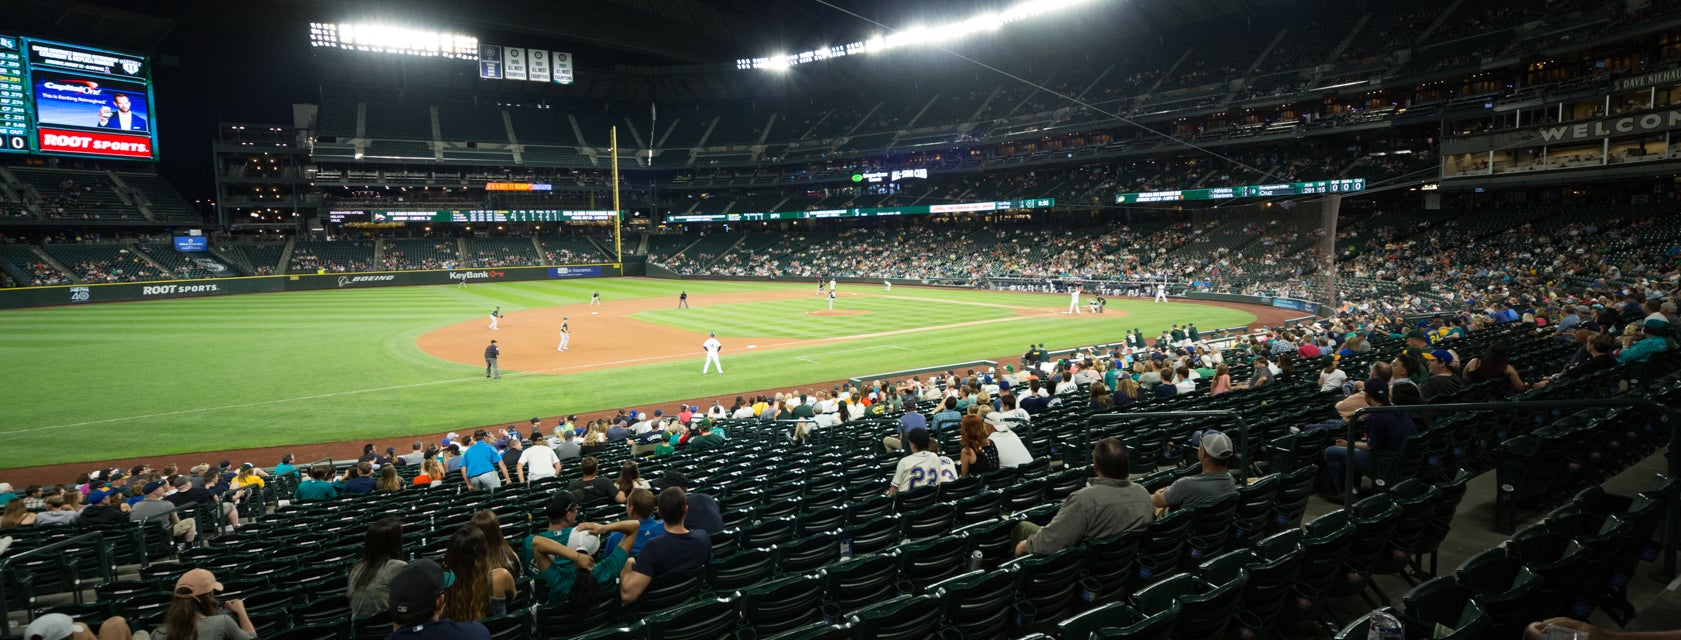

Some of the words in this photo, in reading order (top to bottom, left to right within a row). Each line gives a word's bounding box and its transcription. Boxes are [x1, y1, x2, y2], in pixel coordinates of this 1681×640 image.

[1623, 76, 1646, 89] DAVE
[12, 136, 24, 149] 0
[44, 134, 92, 147] ROOT
[1355, 182, 1362, 190] 0
[450, 271, 489, 280] KeyBank
[143, 285, 177, 295] ROOT
